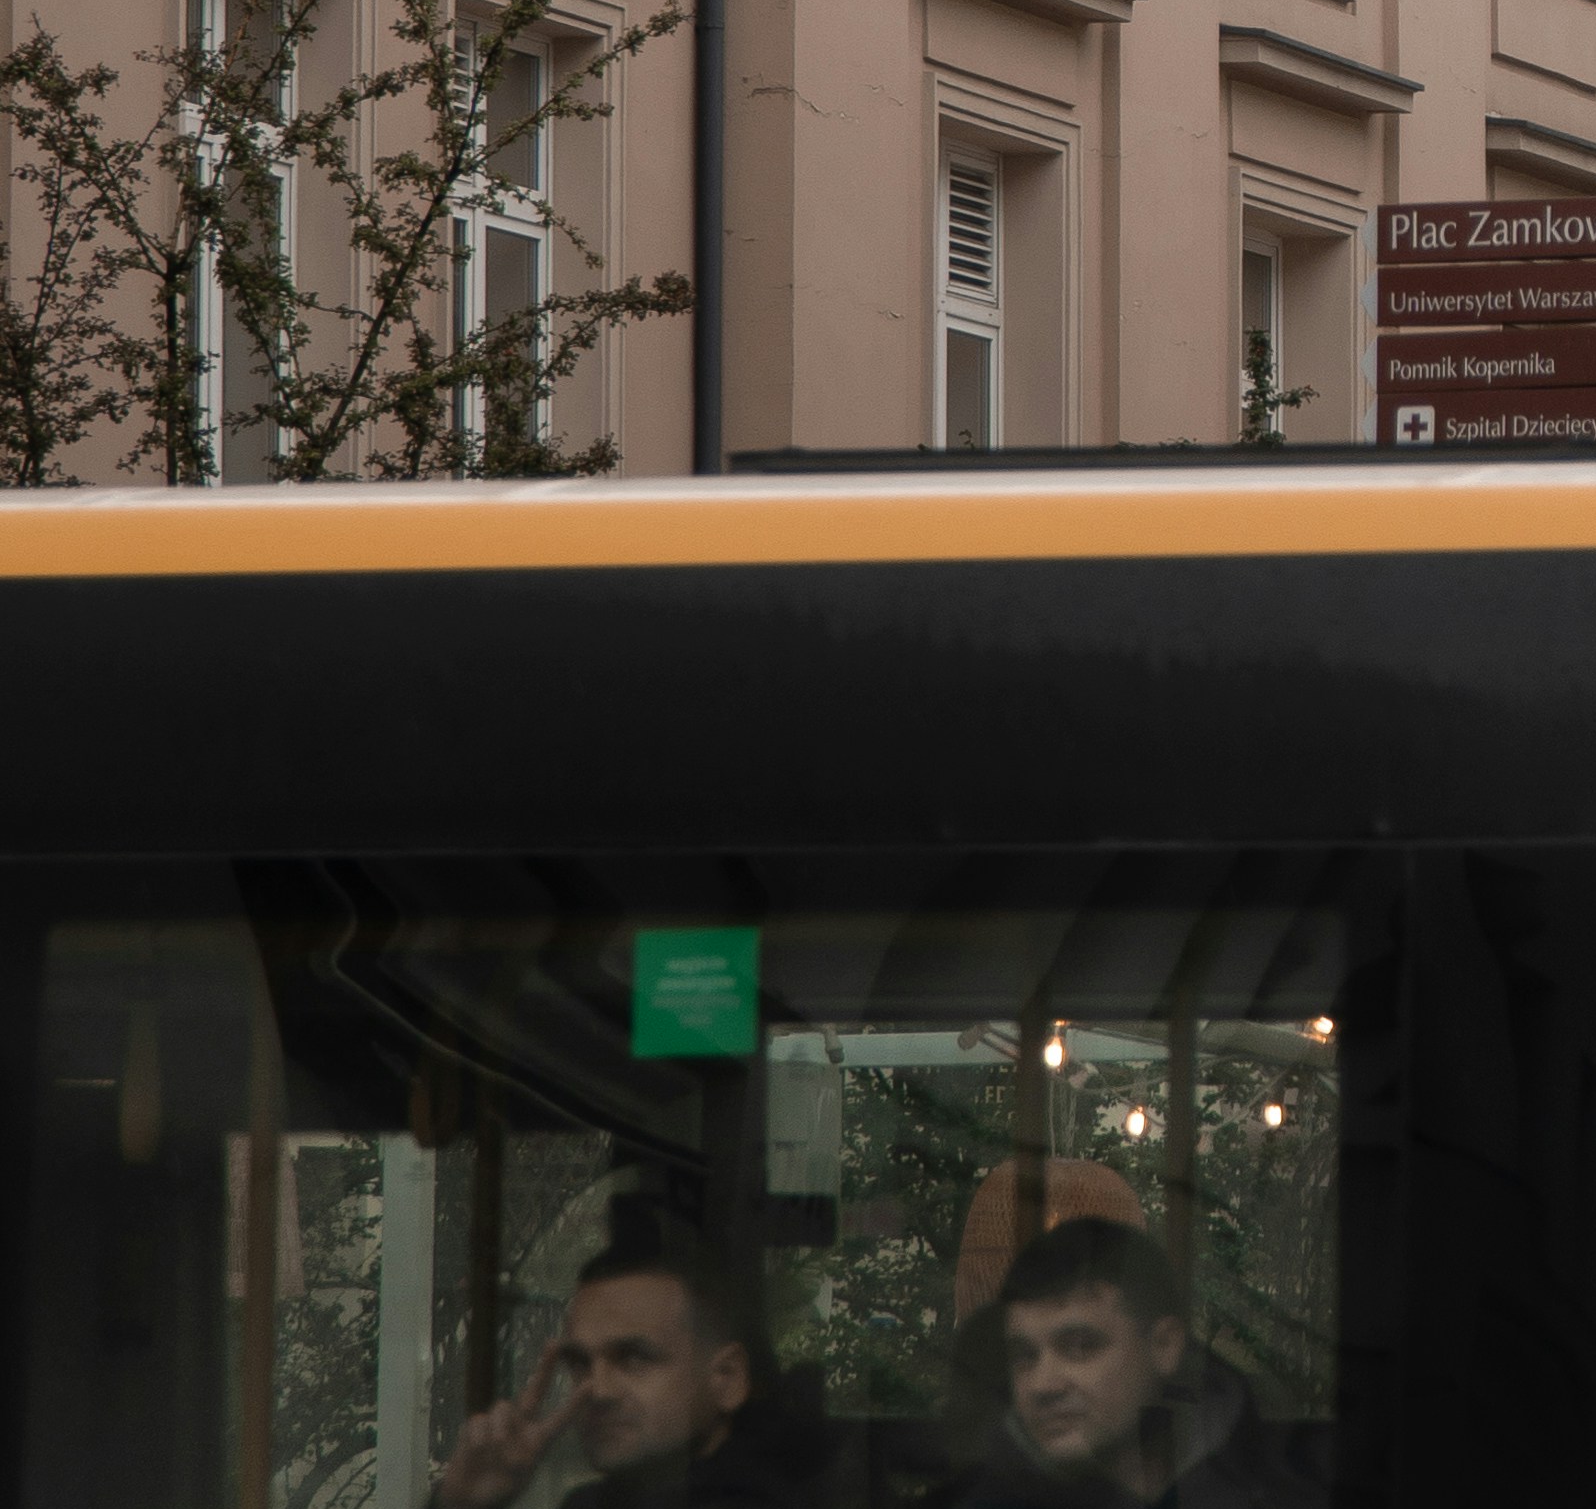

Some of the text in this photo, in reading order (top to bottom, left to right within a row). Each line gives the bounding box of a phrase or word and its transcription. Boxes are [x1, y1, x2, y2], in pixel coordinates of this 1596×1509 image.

[1390, 210, 1457, 250] Plac
[1389, 290, 1514, 318] Uniwersytet
[1389, 355, 1458, 381] Pomnik
[1463, 352, 1556, 384] Kopernika
[1446, 414, 1506, 442] Szpital
